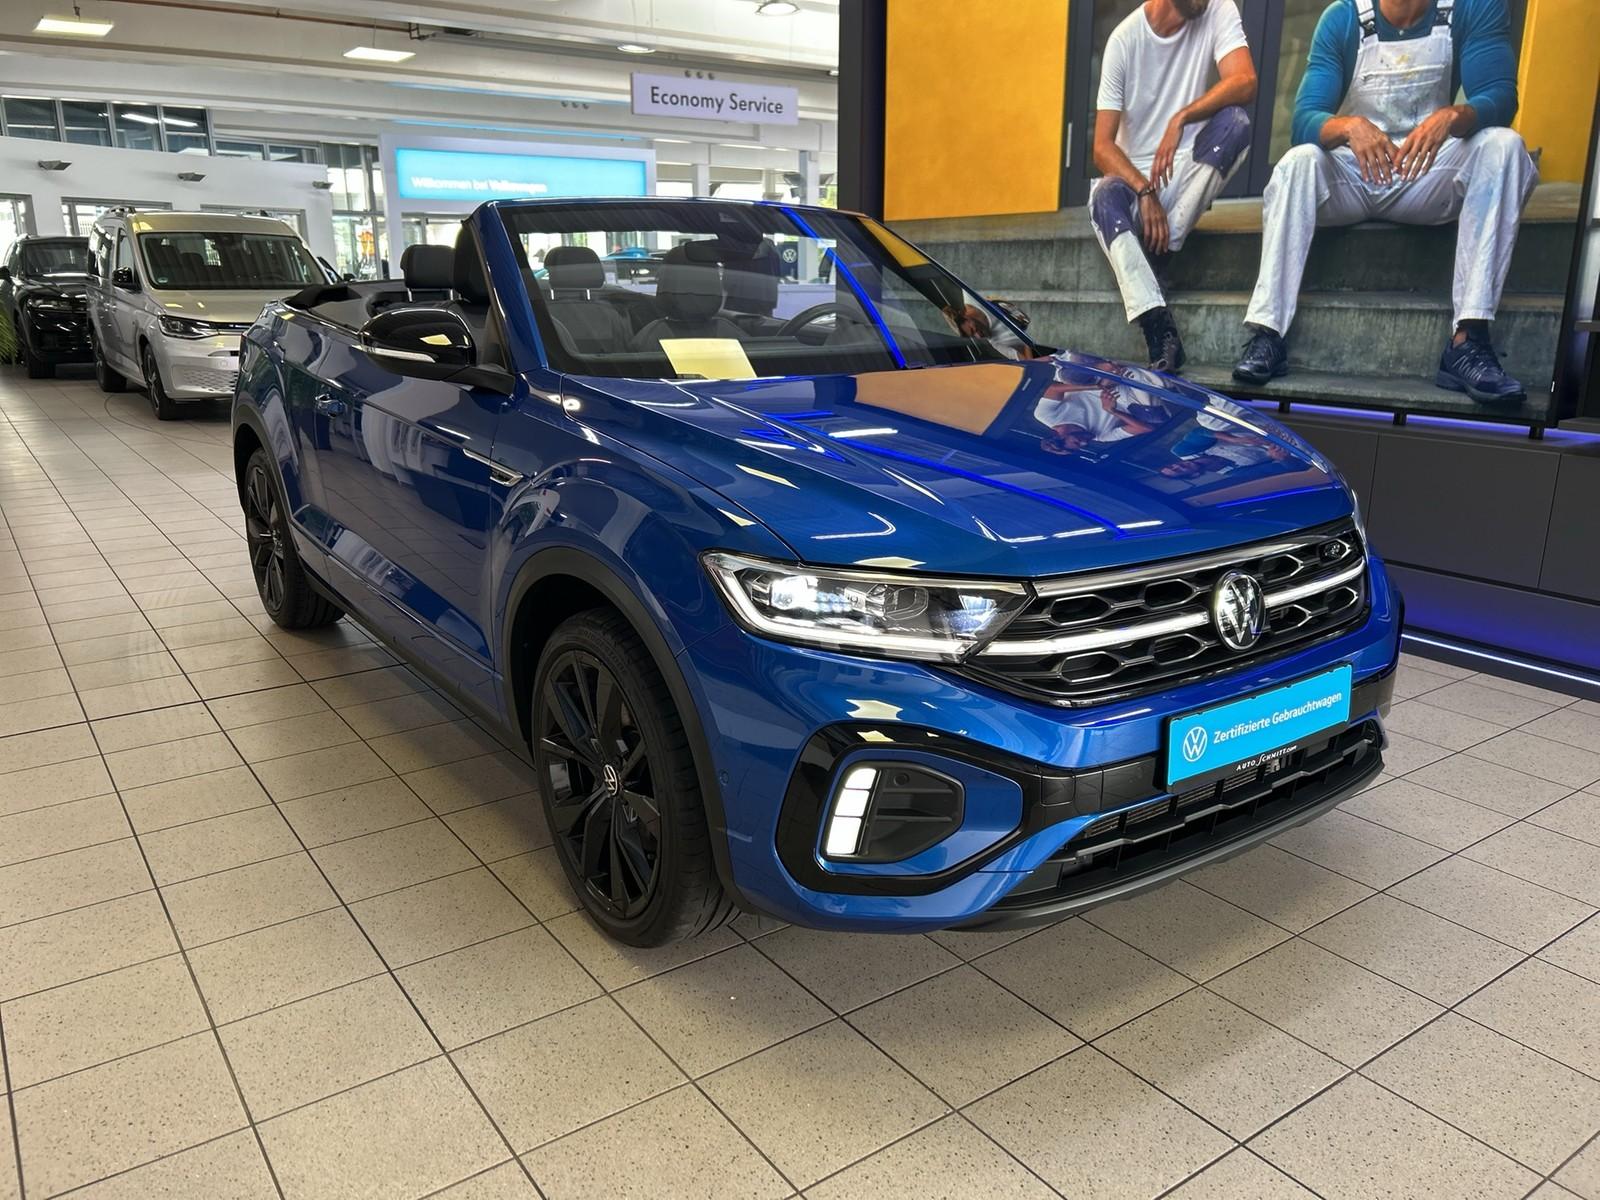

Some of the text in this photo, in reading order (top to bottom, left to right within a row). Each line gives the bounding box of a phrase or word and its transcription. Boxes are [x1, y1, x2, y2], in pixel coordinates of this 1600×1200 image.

[650, 86, 784, 114] Economy Service
[411, 176, 472, 190] Willkommen
[473, 179, 487, 191] bei
[1182, 691, 1342, 762] VW Zertifizierte Gebrauchtwagen
[1236, 760, 1256, 771] AUTO
